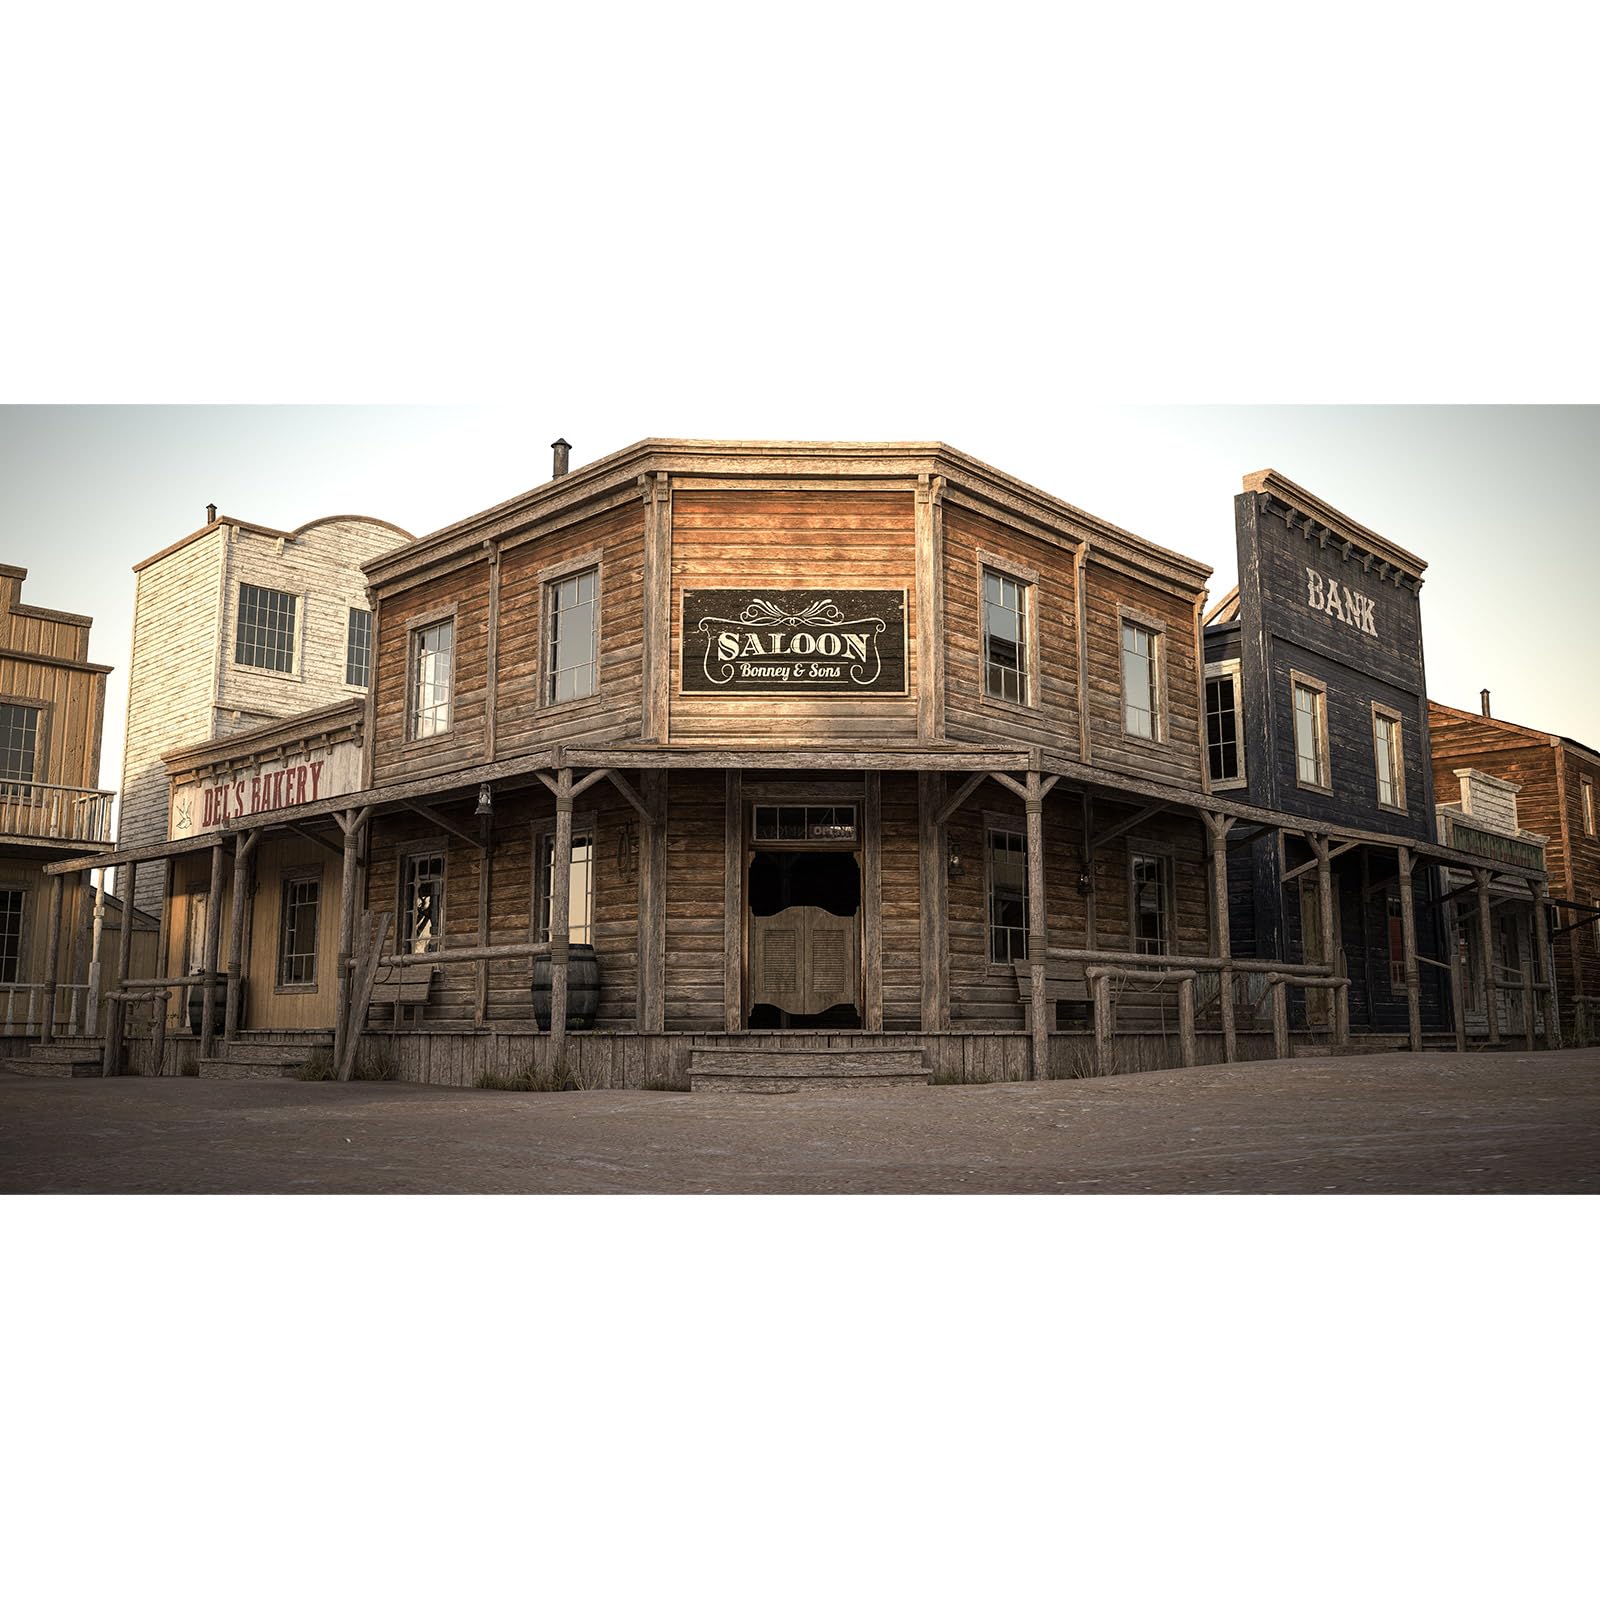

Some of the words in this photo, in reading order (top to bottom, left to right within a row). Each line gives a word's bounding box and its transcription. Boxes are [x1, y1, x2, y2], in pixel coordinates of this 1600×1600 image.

[1306, 567, 1378, 637] BANK
[717, 632, 870, 662] SALOON
[740, 663, 790, 680] Bonney
[794, 663, 806, 677] &
[809, 663, 841, 677] Sons
[203, 781, 246, 827] DEL'S
[251, 761, 324, 813] BAKERY
